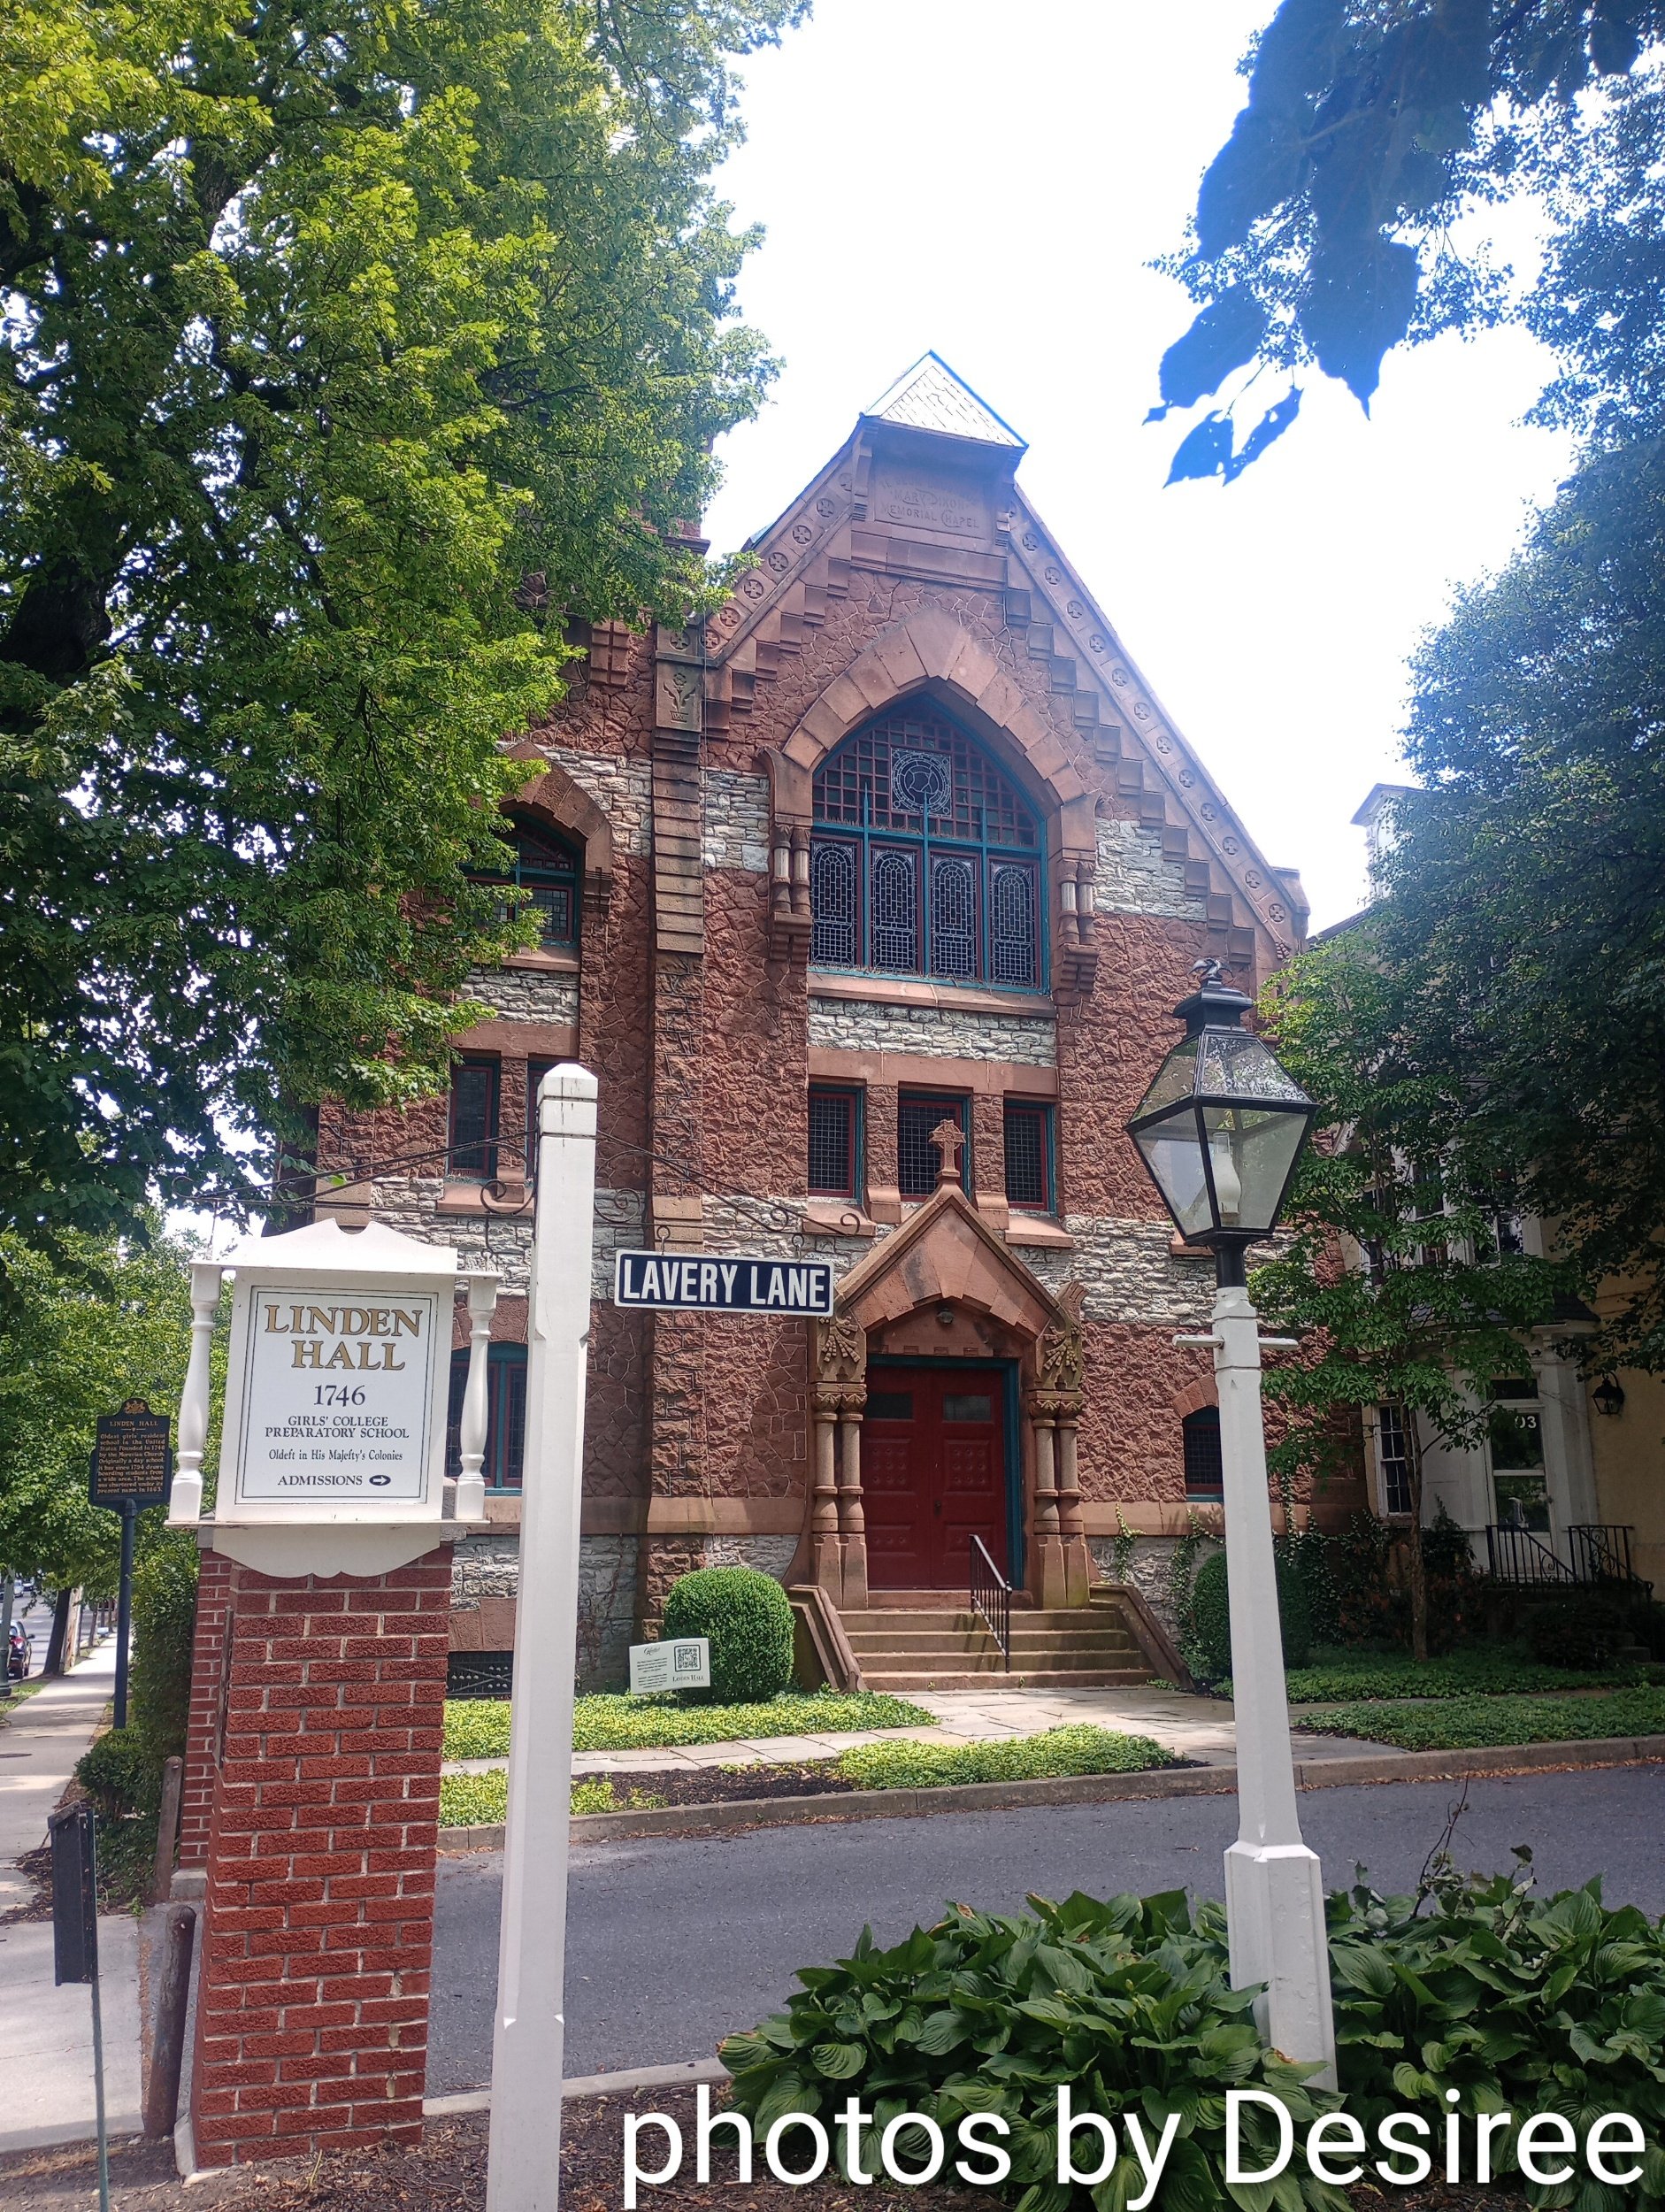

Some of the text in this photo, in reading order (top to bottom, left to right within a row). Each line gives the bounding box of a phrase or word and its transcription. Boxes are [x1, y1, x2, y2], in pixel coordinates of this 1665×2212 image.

[881, 503, 979, 528] MEMORIAL CHAPEL
[623, 1259, 826, 1308] LAVERY LANE
[265, 1304, 423, 1338] LINDEN
[291, 1340, 406, 1371] HALL
[313, 1384, 366, 1408] 1746
[265, 1426, 410, 1439] PREPARATORY SCHOOL
[288, 1416, 388, 1427] GIRLS' COLLEGE
[299, 1449, 307, 1460] in
[311, 1449, 326, 1460] His
[368, 1449, 403, 1461] Colonies
[277, 1475, 363, 1486] ADMISSIONS
